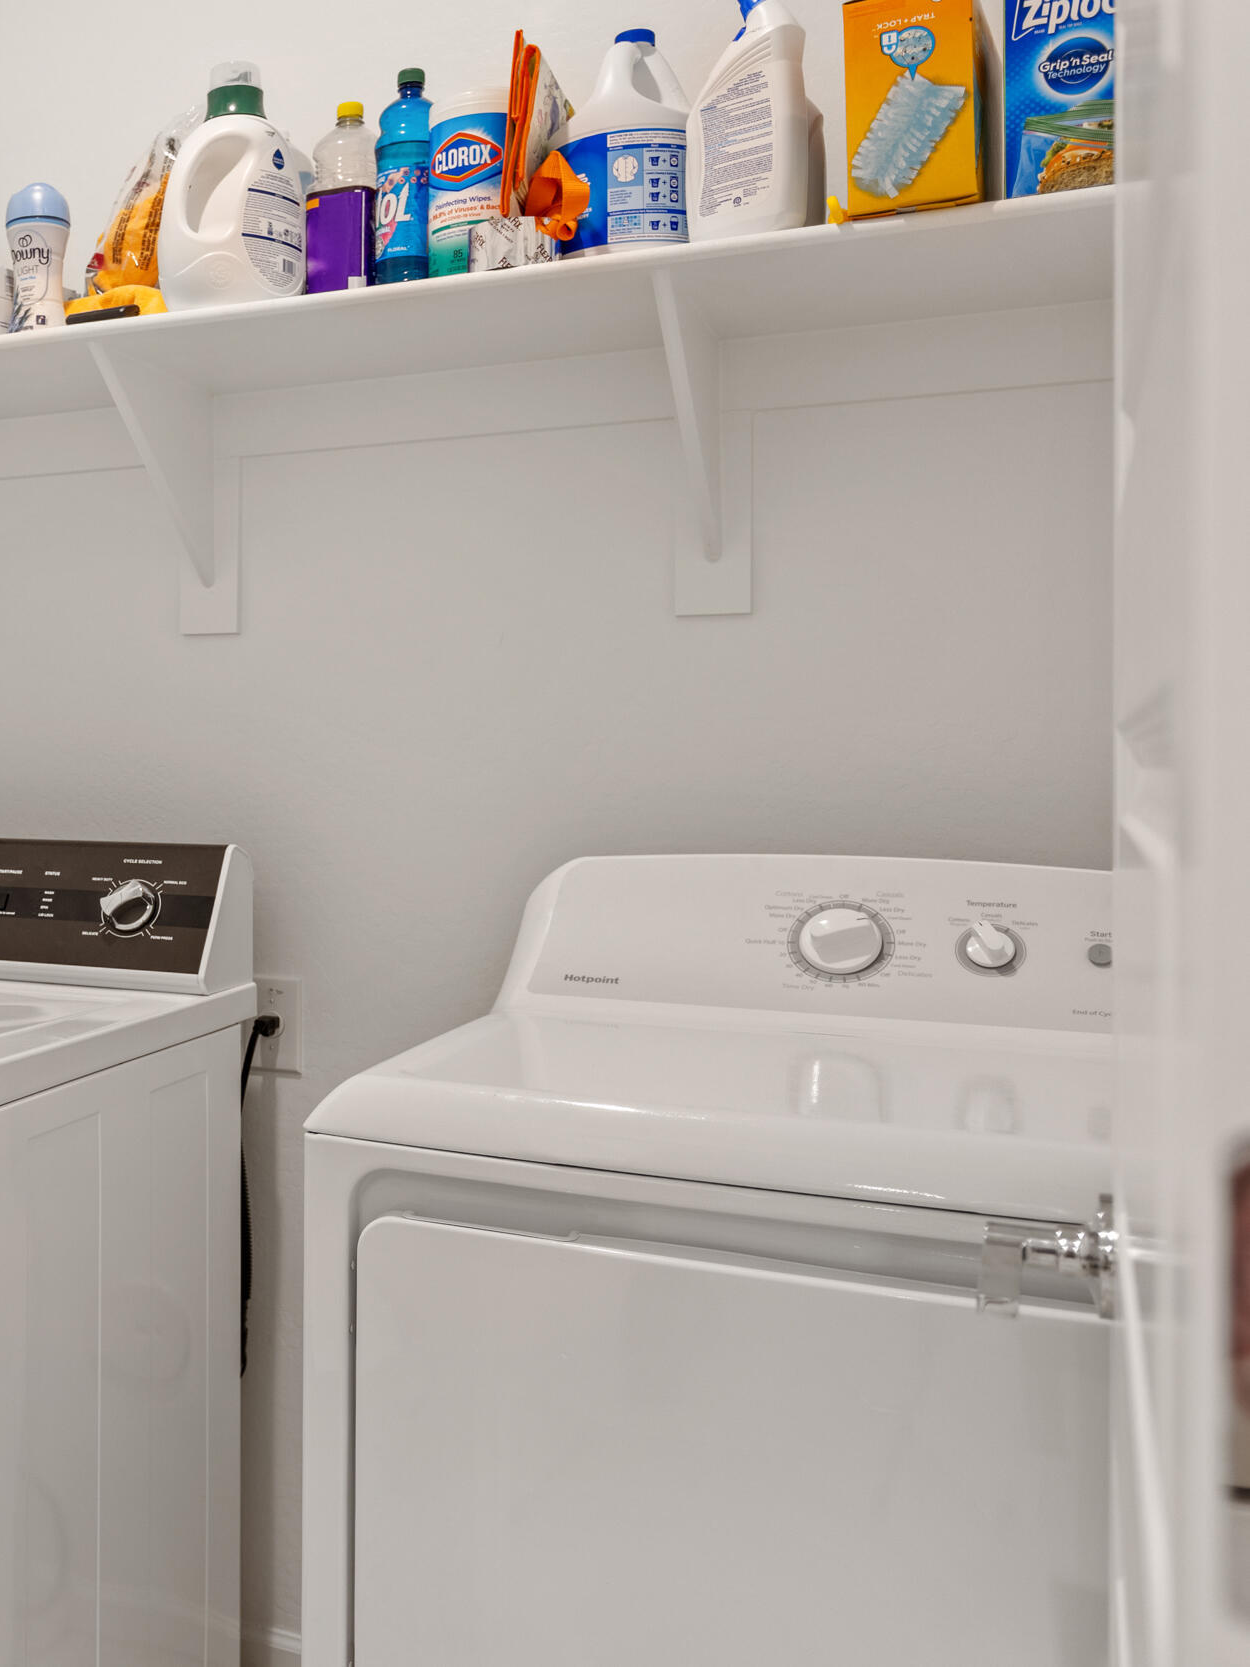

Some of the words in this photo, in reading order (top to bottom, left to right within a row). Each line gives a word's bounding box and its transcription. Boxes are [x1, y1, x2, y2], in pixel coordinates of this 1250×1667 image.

[1081, 50, 1113, 65] Seal
[1047, 63, 1107, 80] Technology
[434, 143, 492, 175] CLOROX
[966, 900, 1017, 908] Temperature
[1090, 930, 1113, 938] Start
[564, 974, 620, 985] Hotpoint
